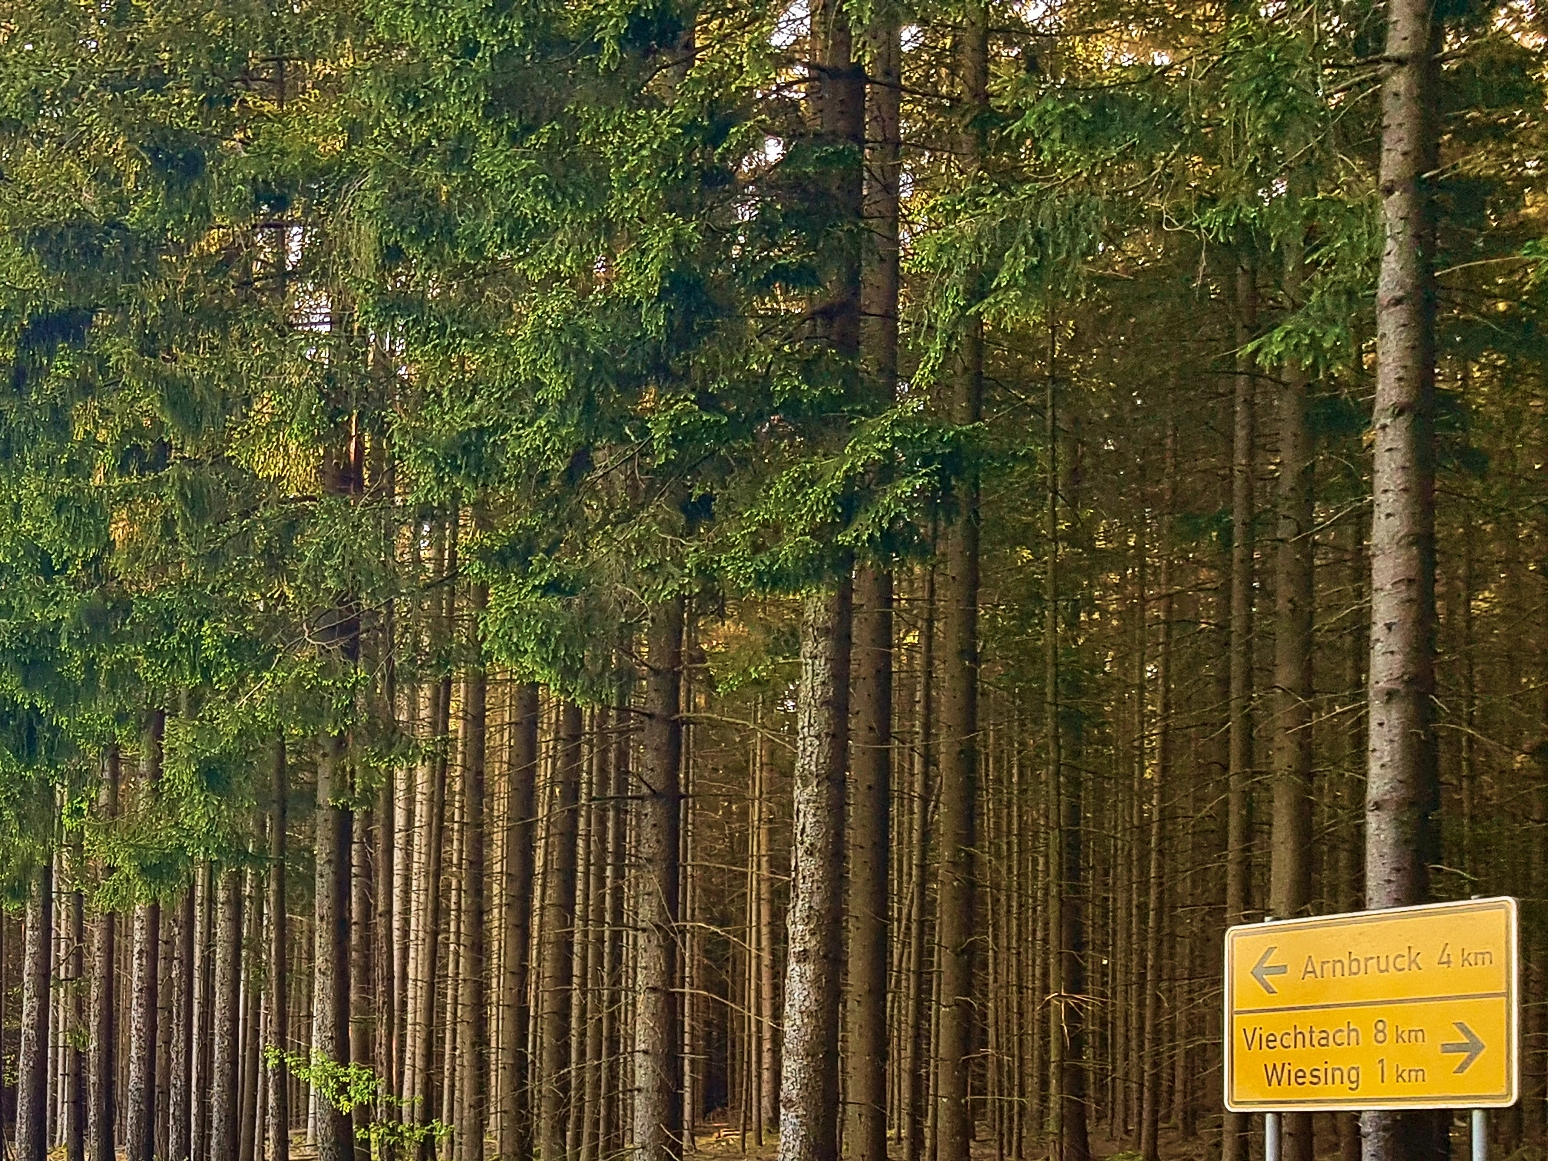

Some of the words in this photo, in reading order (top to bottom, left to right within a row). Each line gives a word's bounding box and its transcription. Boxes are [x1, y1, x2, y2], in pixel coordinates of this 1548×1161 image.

[1301, 946, 1423, 981] Arnbruck
[1437, 942, 1452, 968] 4
[1460, 947, 1493, 967] km
[1242, 1021, 1361, 1051] Viechtach
[1373, 1019, 1387, 1044] 8
[1395, 1025, 1426, 1044] km
[1263, 1060, 1361, 1092] Wiesing
[1377, 1058, 1386, 1084] 1
[1395, 1064, 1426, 1083] km
